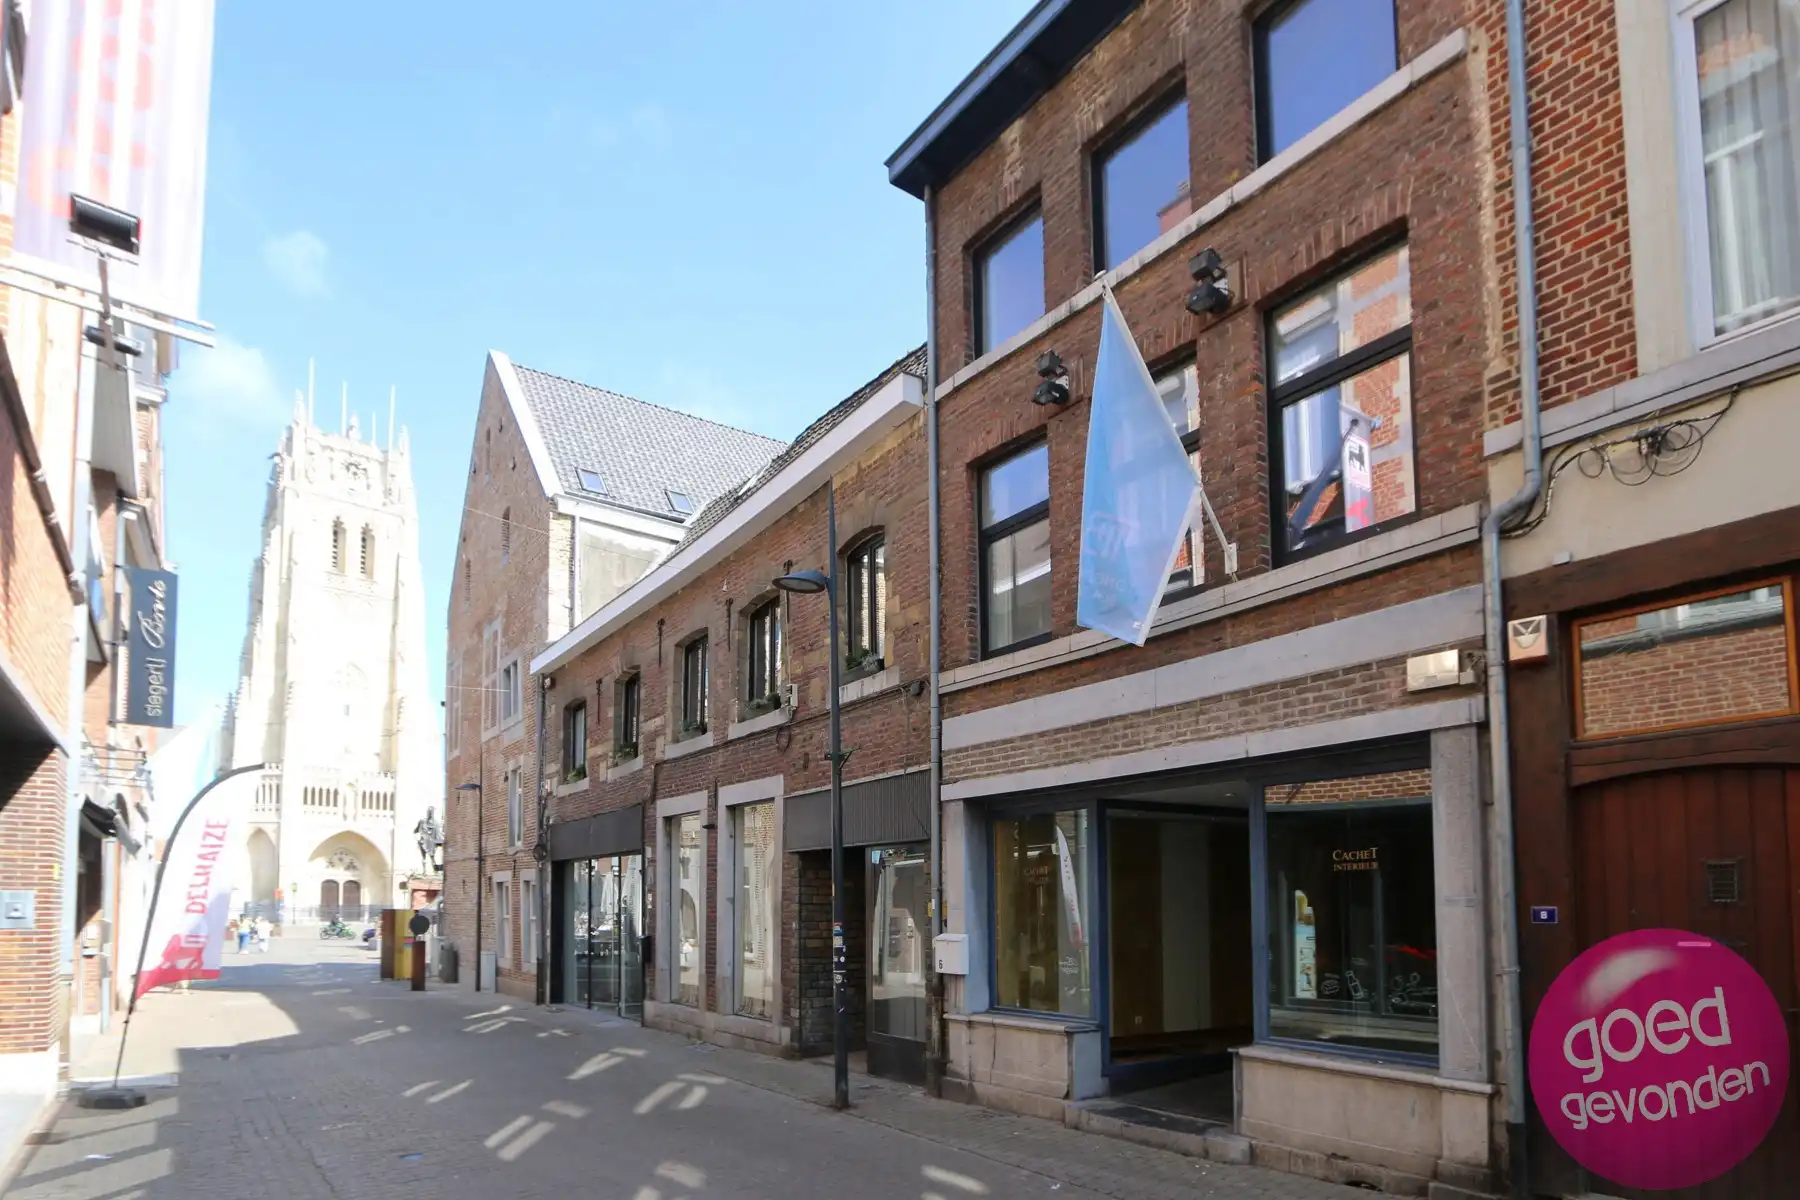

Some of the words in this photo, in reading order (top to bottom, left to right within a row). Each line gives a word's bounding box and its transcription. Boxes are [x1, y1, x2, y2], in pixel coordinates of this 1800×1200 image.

[144, 656, 168, 717] slagerij
[184, 818, 229, 915] DELHAIZE
[1332, 847, 1379, 861] CACHET
[938, 959, 943, 970] 6
